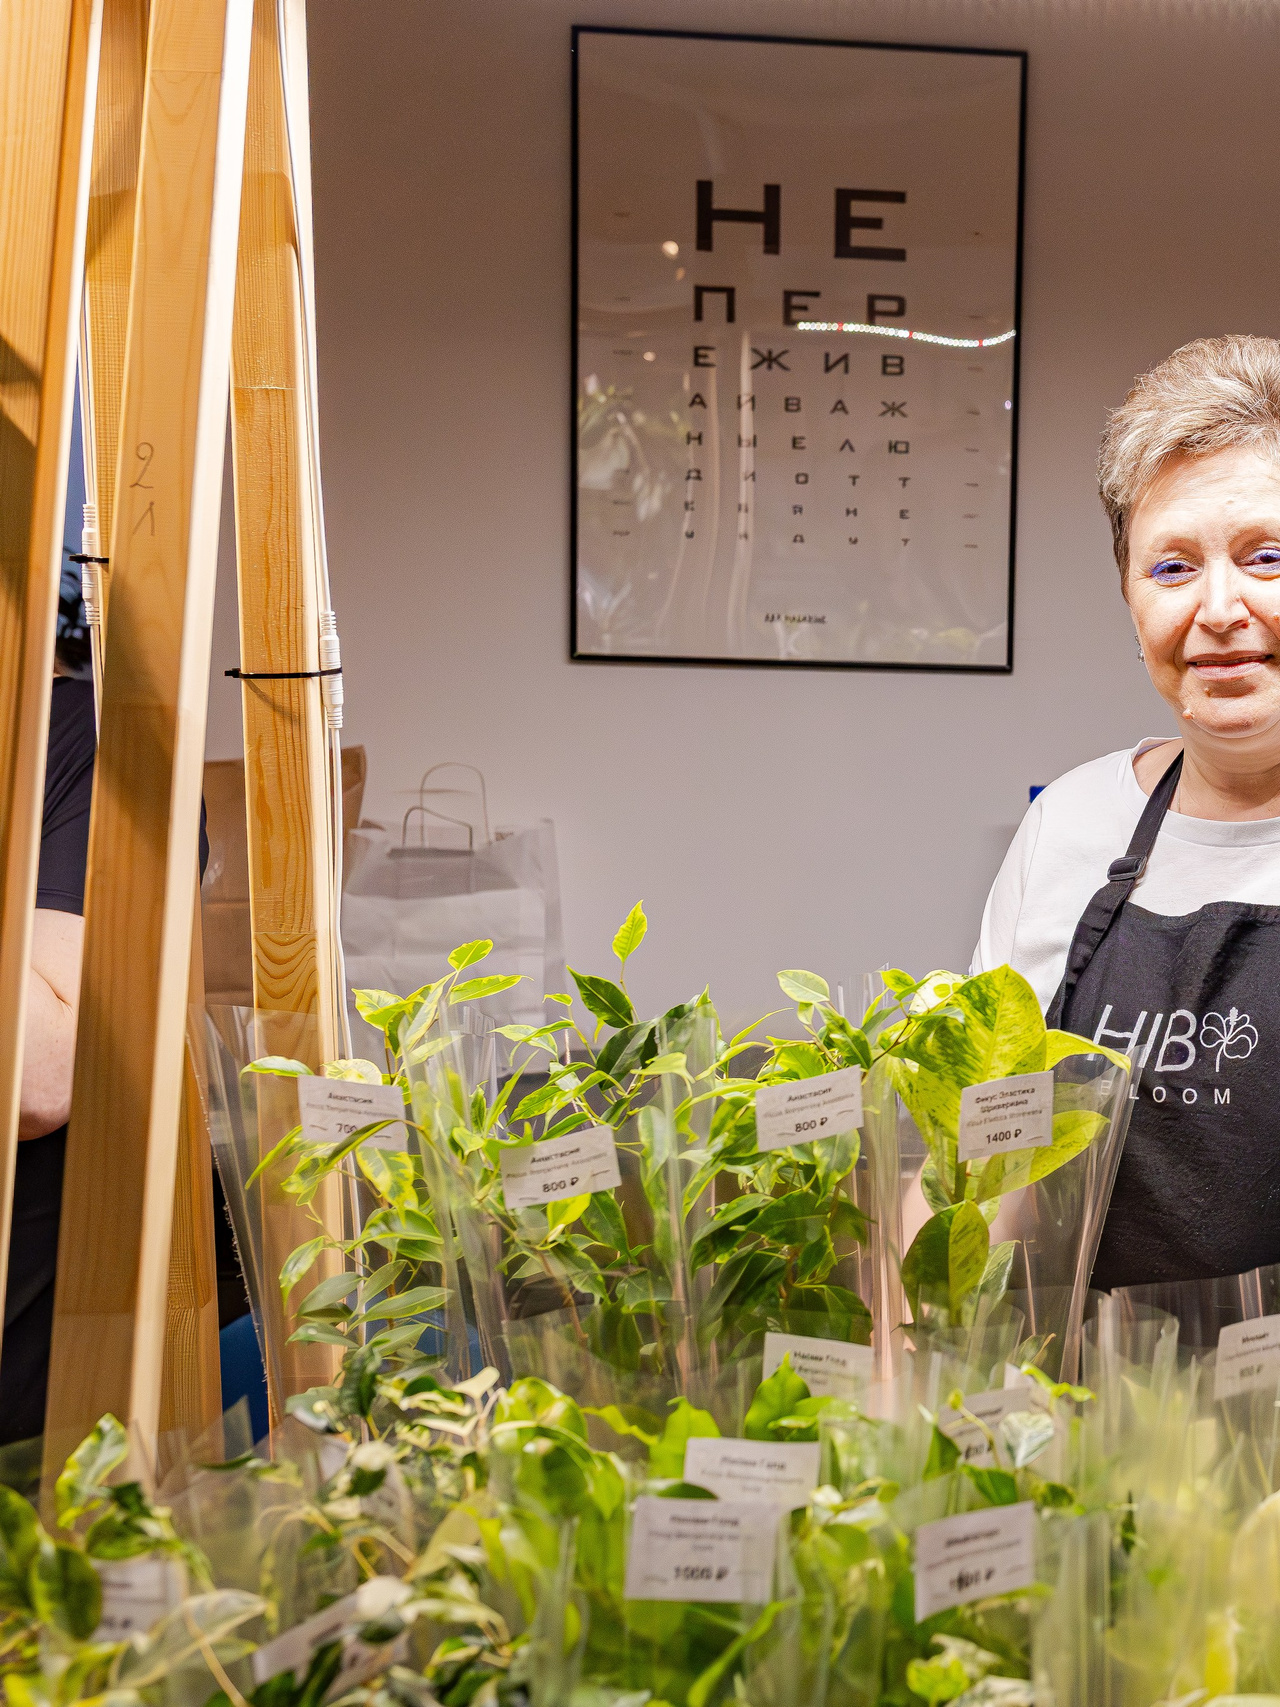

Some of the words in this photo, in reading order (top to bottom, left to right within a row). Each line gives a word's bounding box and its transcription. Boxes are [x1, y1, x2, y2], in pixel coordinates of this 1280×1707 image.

[695, 179, 907, 262] НЕ
[693, 284, 906, 327] ПЕР
[693, 345, 905, 377] ЕЖИВ
[1100, 1080, 1231, 1105] BLOOM
[795, 1120, 817, 1133] 800
[986, 1130, 1011, 1144] 1400
[542, 1180, 566, 1192] 800
